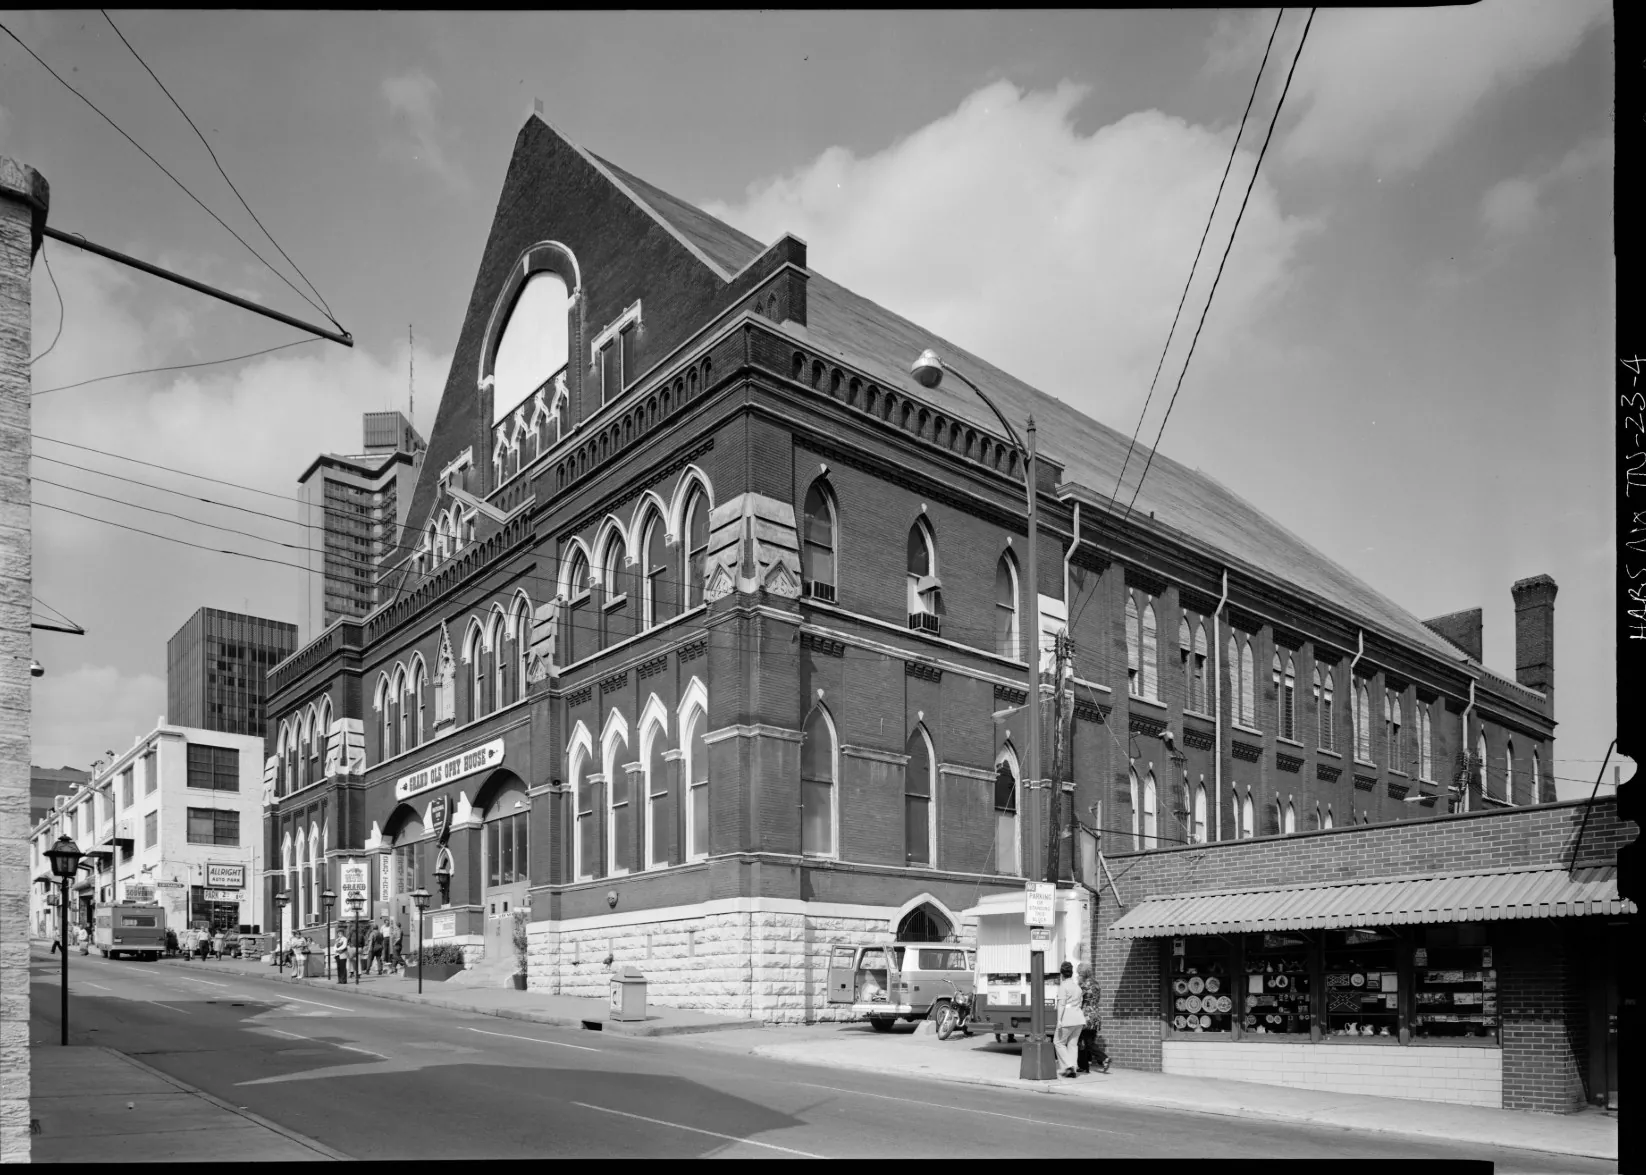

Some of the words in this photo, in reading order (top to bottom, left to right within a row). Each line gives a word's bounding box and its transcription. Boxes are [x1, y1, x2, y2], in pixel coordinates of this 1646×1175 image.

[409, 771, 428, 792] GRAND
[430, 765, 442, 784] OLE
[444, 758, 461, 779] OPRY
[463, 748, 486, 772] HOUSE
[210, 867, 242, 876] ALLRIGHT
[1027, 883, 1036, 891] NO
[1029, 892, 1052, 900] PARKING
